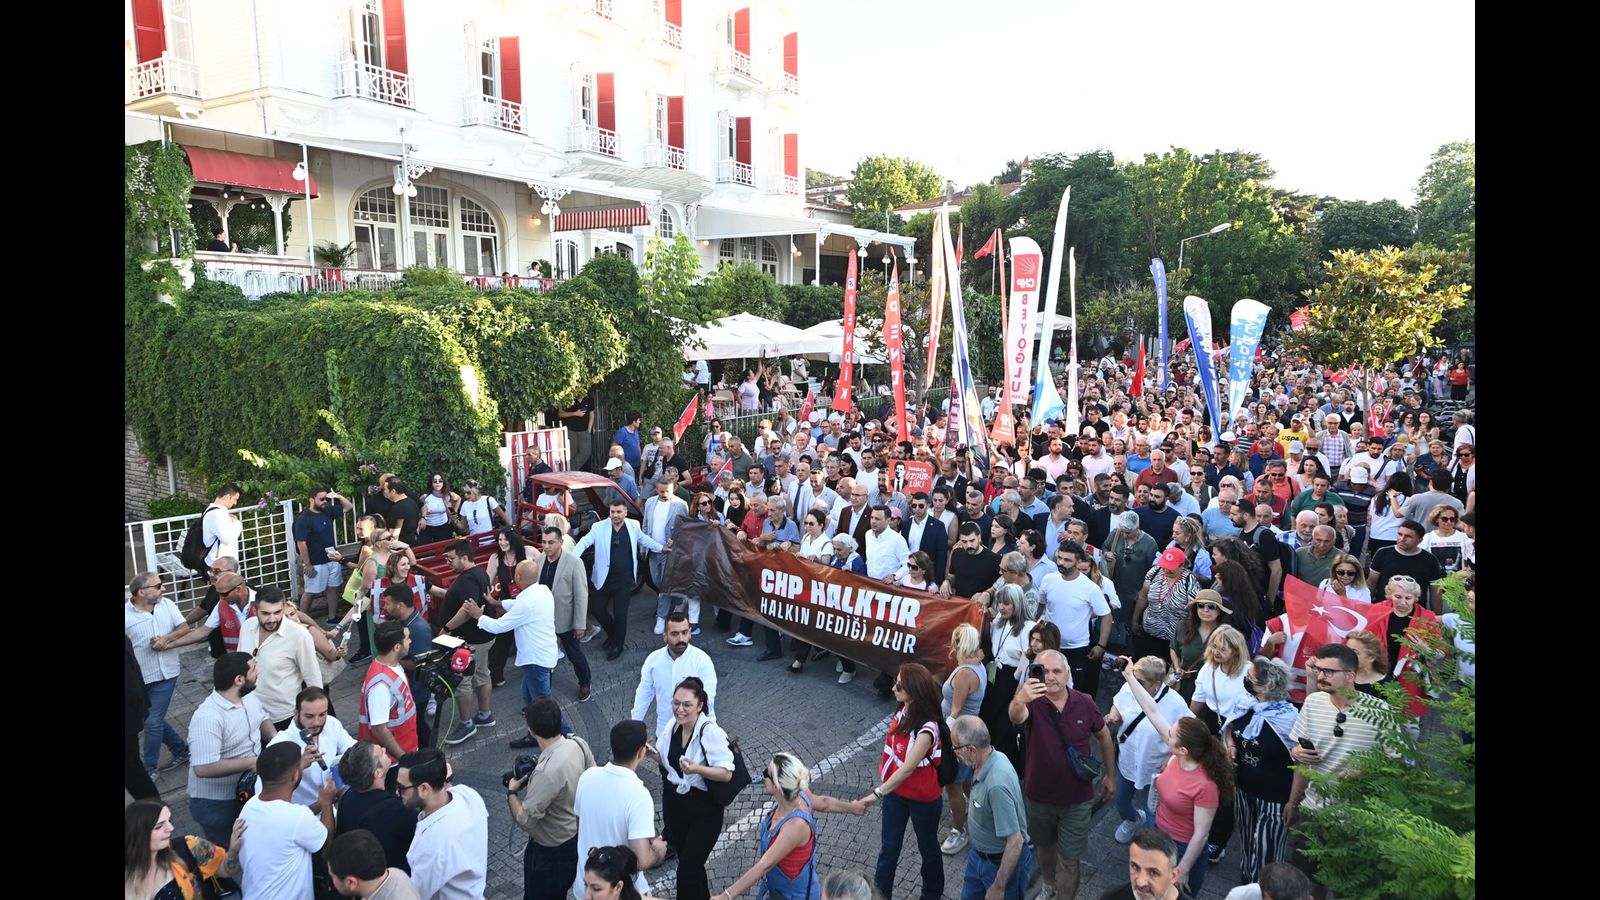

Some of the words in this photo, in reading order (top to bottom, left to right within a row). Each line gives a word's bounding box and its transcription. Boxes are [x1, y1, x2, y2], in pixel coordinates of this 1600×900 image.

[760, 596, 810, 626] HALKIN
[815, 610, 867, 642] DEDİĞİ
[871, 626, 917, 654] OLUR
[761, 568, 804, 600] CHP
[810, 579, 921, 628] HALKTIR
